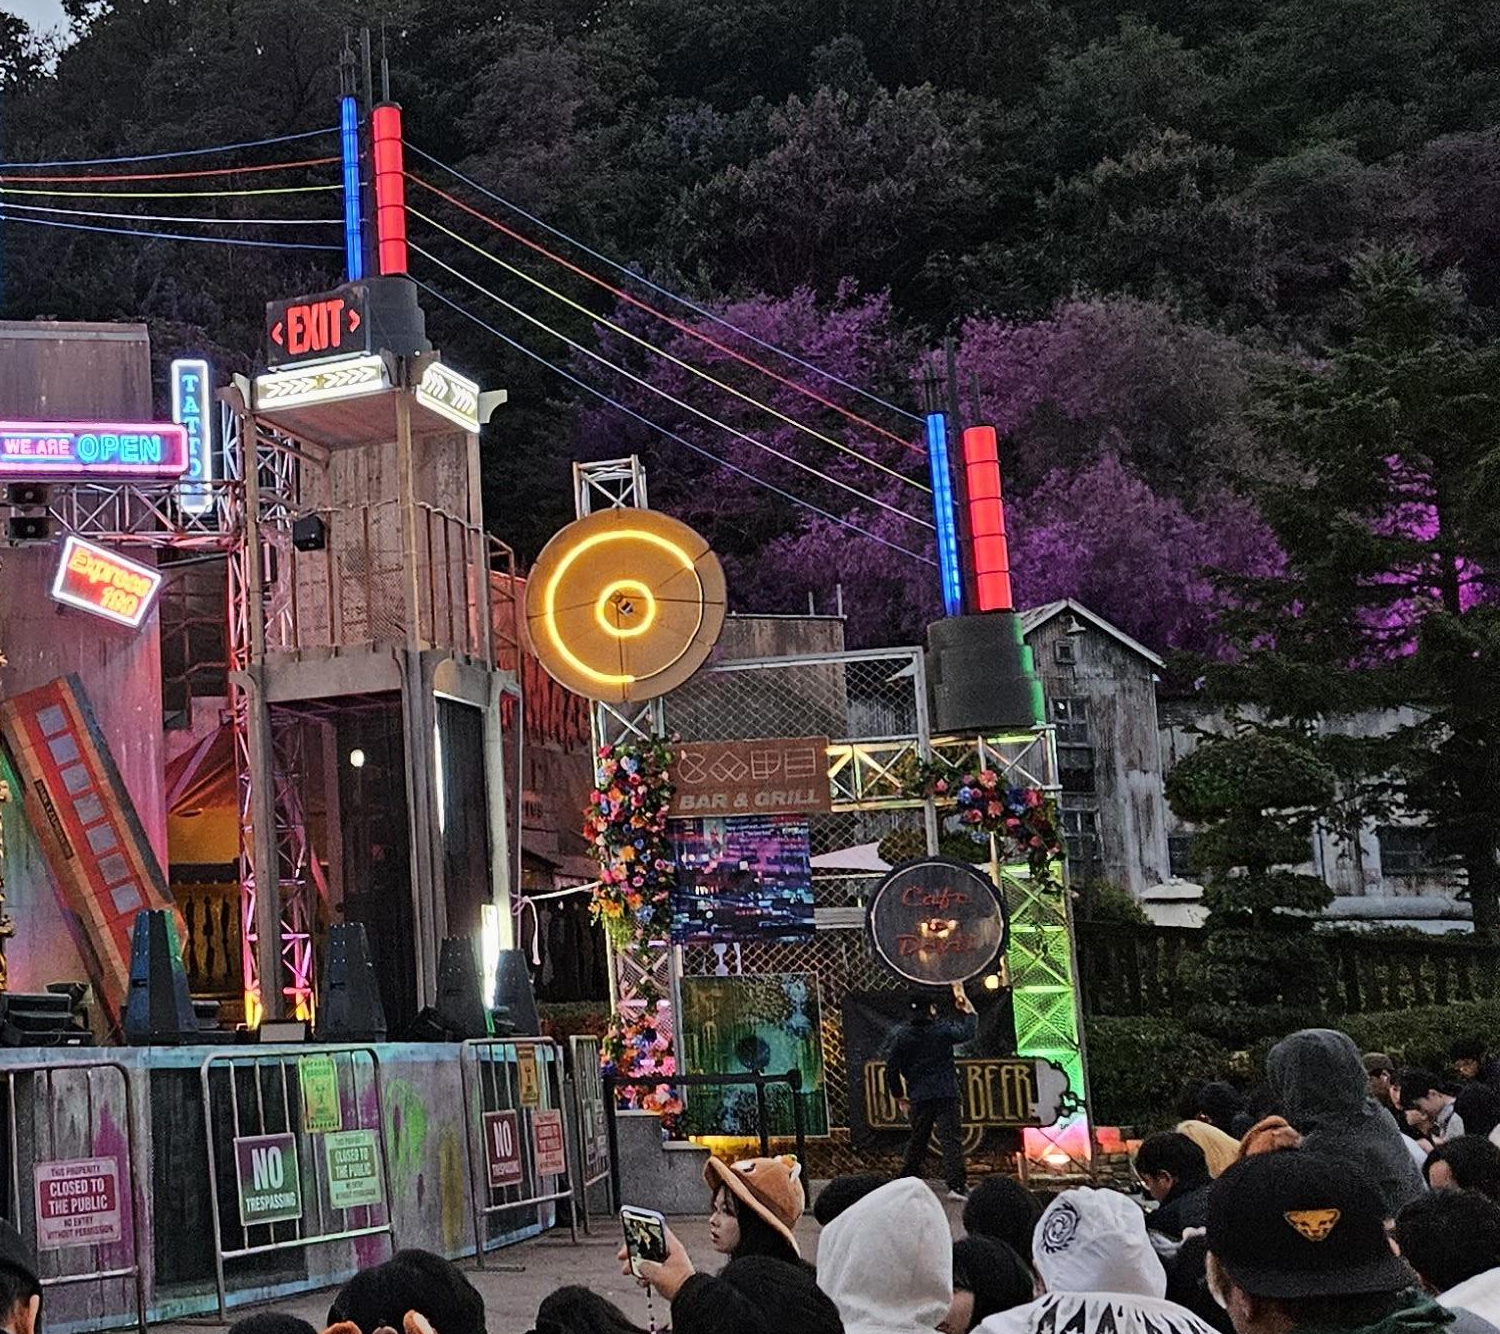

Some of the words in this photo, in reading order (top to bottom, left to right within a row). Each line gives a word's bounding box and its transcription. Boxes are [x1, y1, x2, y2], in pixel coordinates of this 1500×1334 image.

[287, 299, 345, 355] EXIT
[4, 438, 31, 455] WE
[36, 438, 71, 456] ARE
[77, 433, 162, 464] OPEN
[679, 793, 728, 811] BAR
[733, 792, 749, 808] &
[754, 788, 821, 807] GRILL
[967, 1064, 1032, 1121] BEER
[493, 1120, 513, 1159] NO
[251, 1146, 284, 1191] NO
[49, 1179, 88, 1197] CLOSED
[90, 1177, 105, 1193] TO
[48, 1199, 69, 1216] THE
[71, 1194, 108, 1213] PUBLIC
